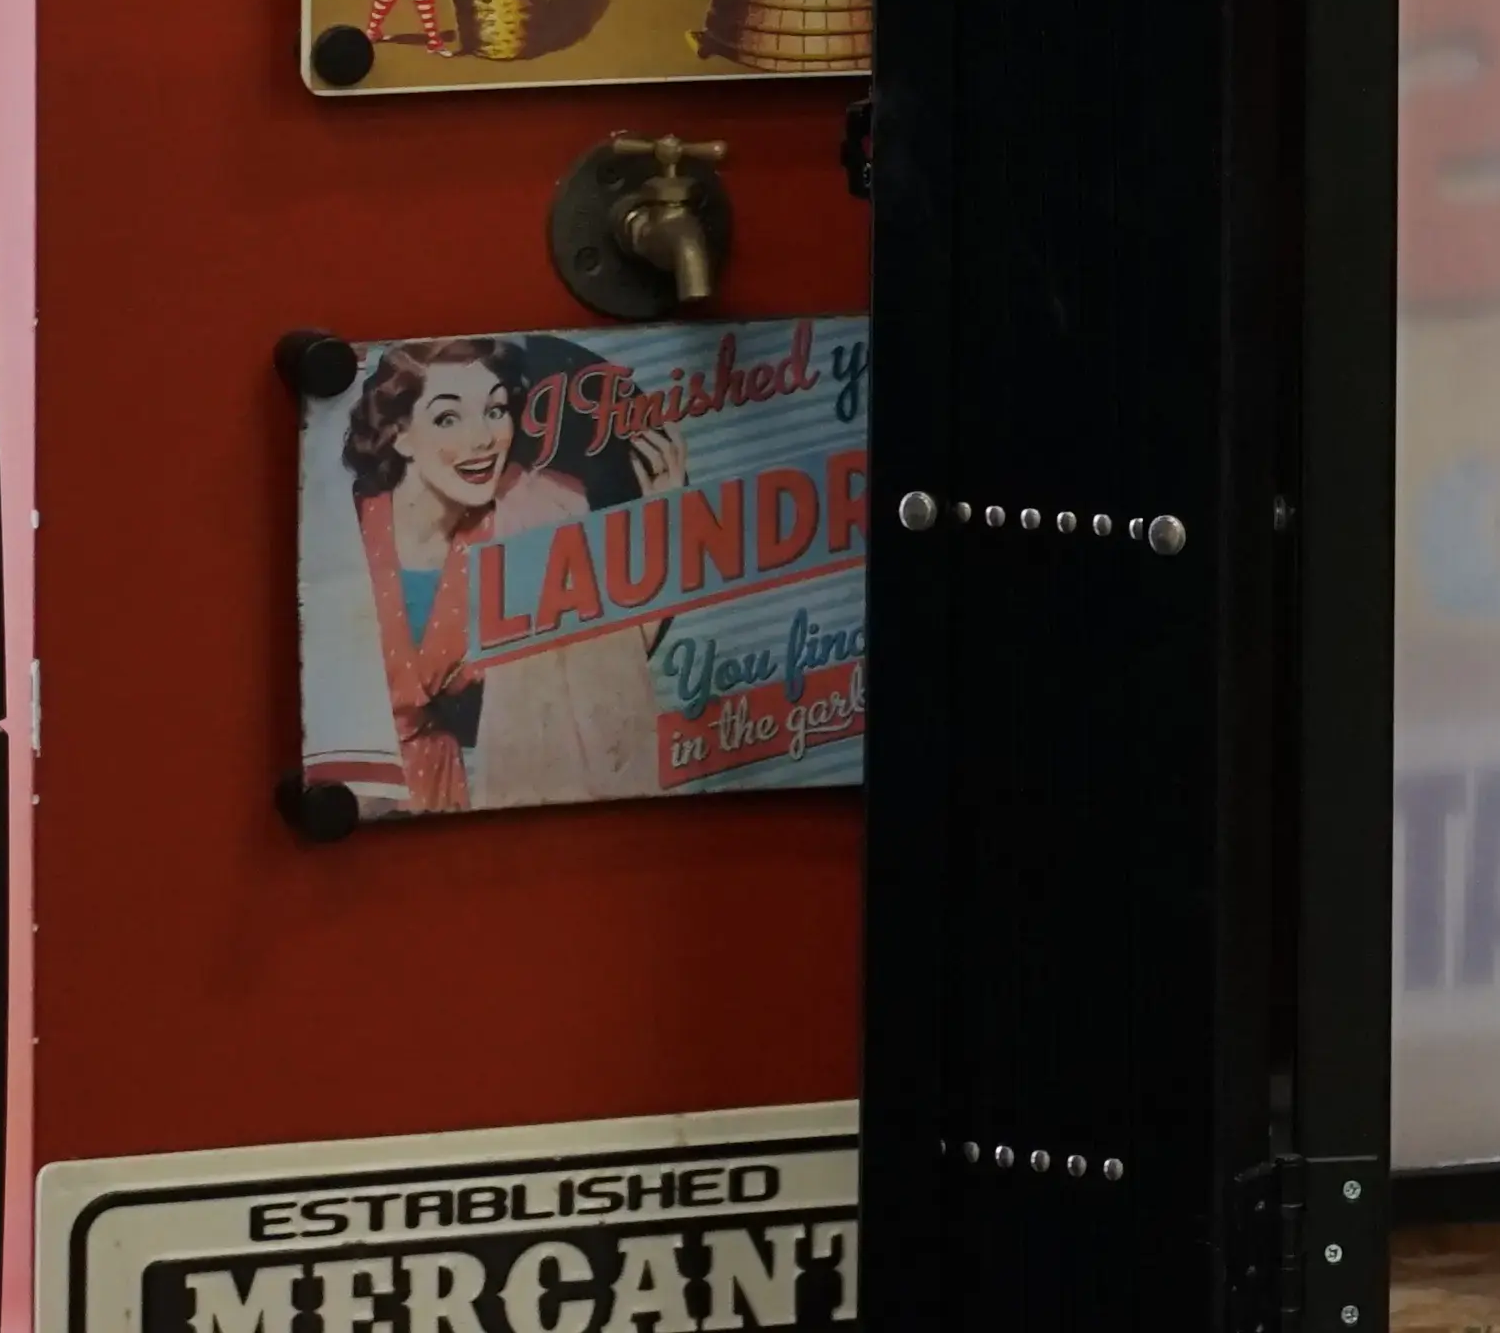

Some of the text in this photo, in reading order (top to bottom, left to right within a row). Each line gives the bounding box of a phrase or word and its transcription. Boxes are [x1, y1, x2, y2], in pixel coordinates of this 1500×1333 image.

[569, 321, 822, 456] Finished
[663, 636, 777, 718] You
[709, 700, 779, 754] the
[247, 1164, 781, 1244] ESTABLISHED
